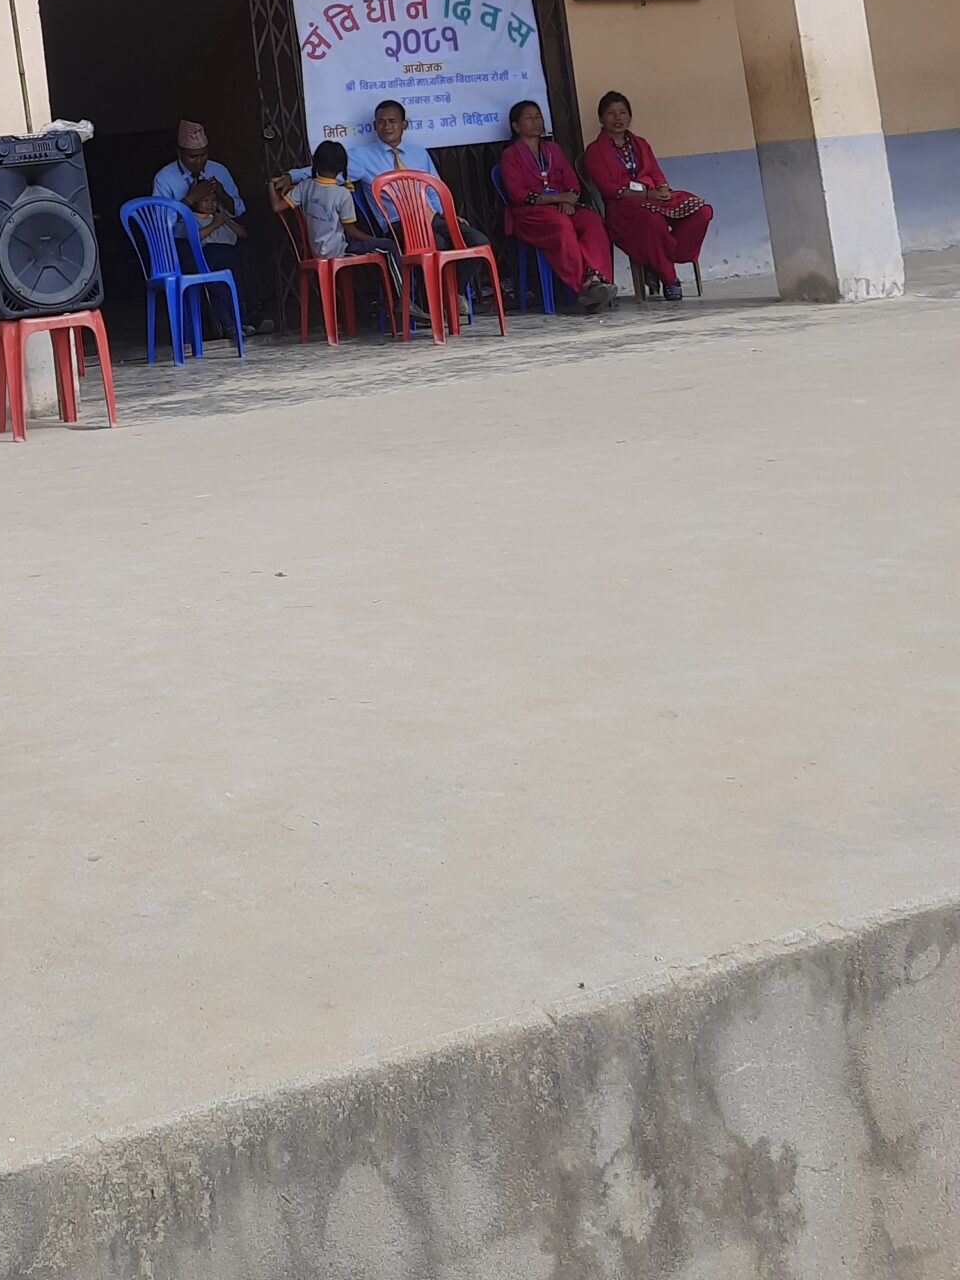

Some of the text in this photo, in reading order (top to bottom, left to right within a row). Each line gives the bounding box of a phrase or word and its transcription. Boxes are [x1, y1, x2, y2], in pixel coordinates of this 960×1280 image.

[382, 26, 459, 61] २०८१
[403, 61, 443, 74] आयोजक
[345, 80, 356, 92] श्री
[455, 72, 489, 84] विद्यालय
[324, 125, 347, 138] मिति
[440, 116, 457, 128] गते
